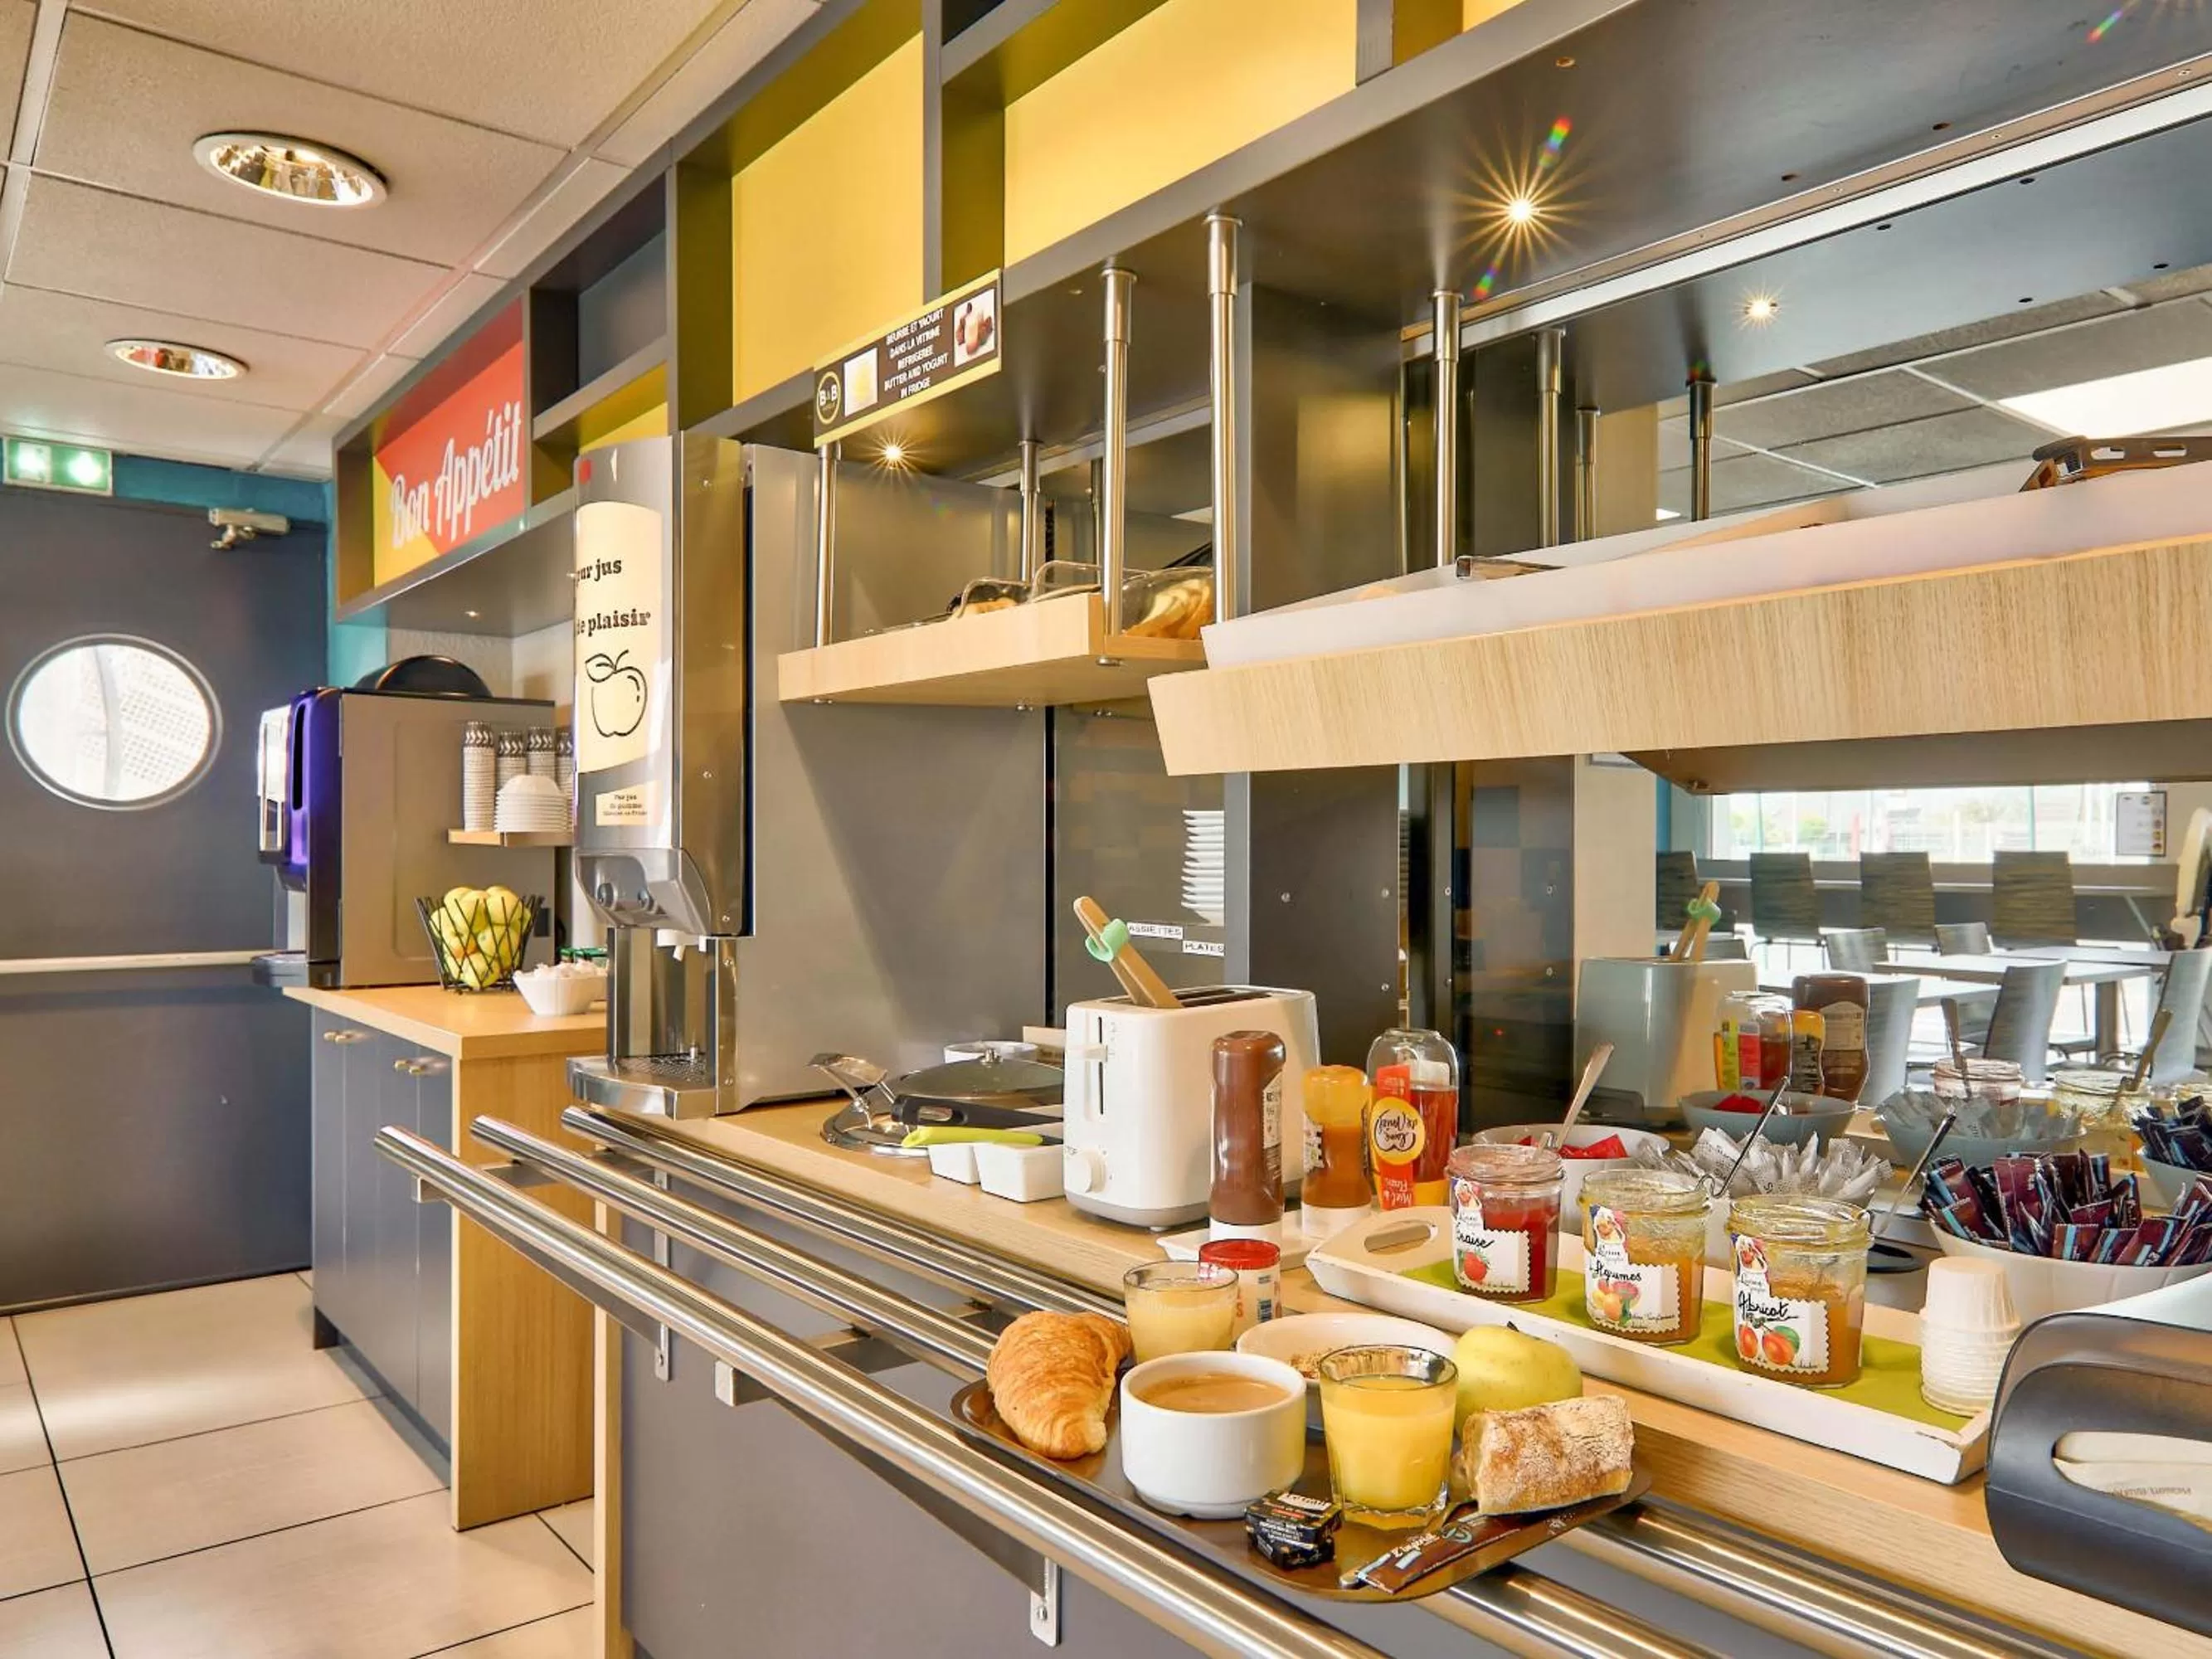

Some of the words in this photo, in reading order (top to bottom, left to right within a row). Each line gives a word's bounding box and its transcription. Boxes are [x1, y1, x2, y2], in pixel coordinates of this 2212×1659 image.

[884, 372, 907, 392] BUTTER
[921, 352, 949, 373] YOGURT
[907, 377, 931, 396] FRIDGE
[391, 474, 430, 550] Bon
[434, 401, 522, 543] Appétit
[594, 558, 622, 582] jus
[587, 608, 651, 637] plaisir
[1129, 925, 1182, 936] ASSIETTES
[1185, 943, 1224, 953] PLATES
[1593, 1259, 1642, 1287] Agrumes
[1738, 1290, 1790, 1321] Abricot
